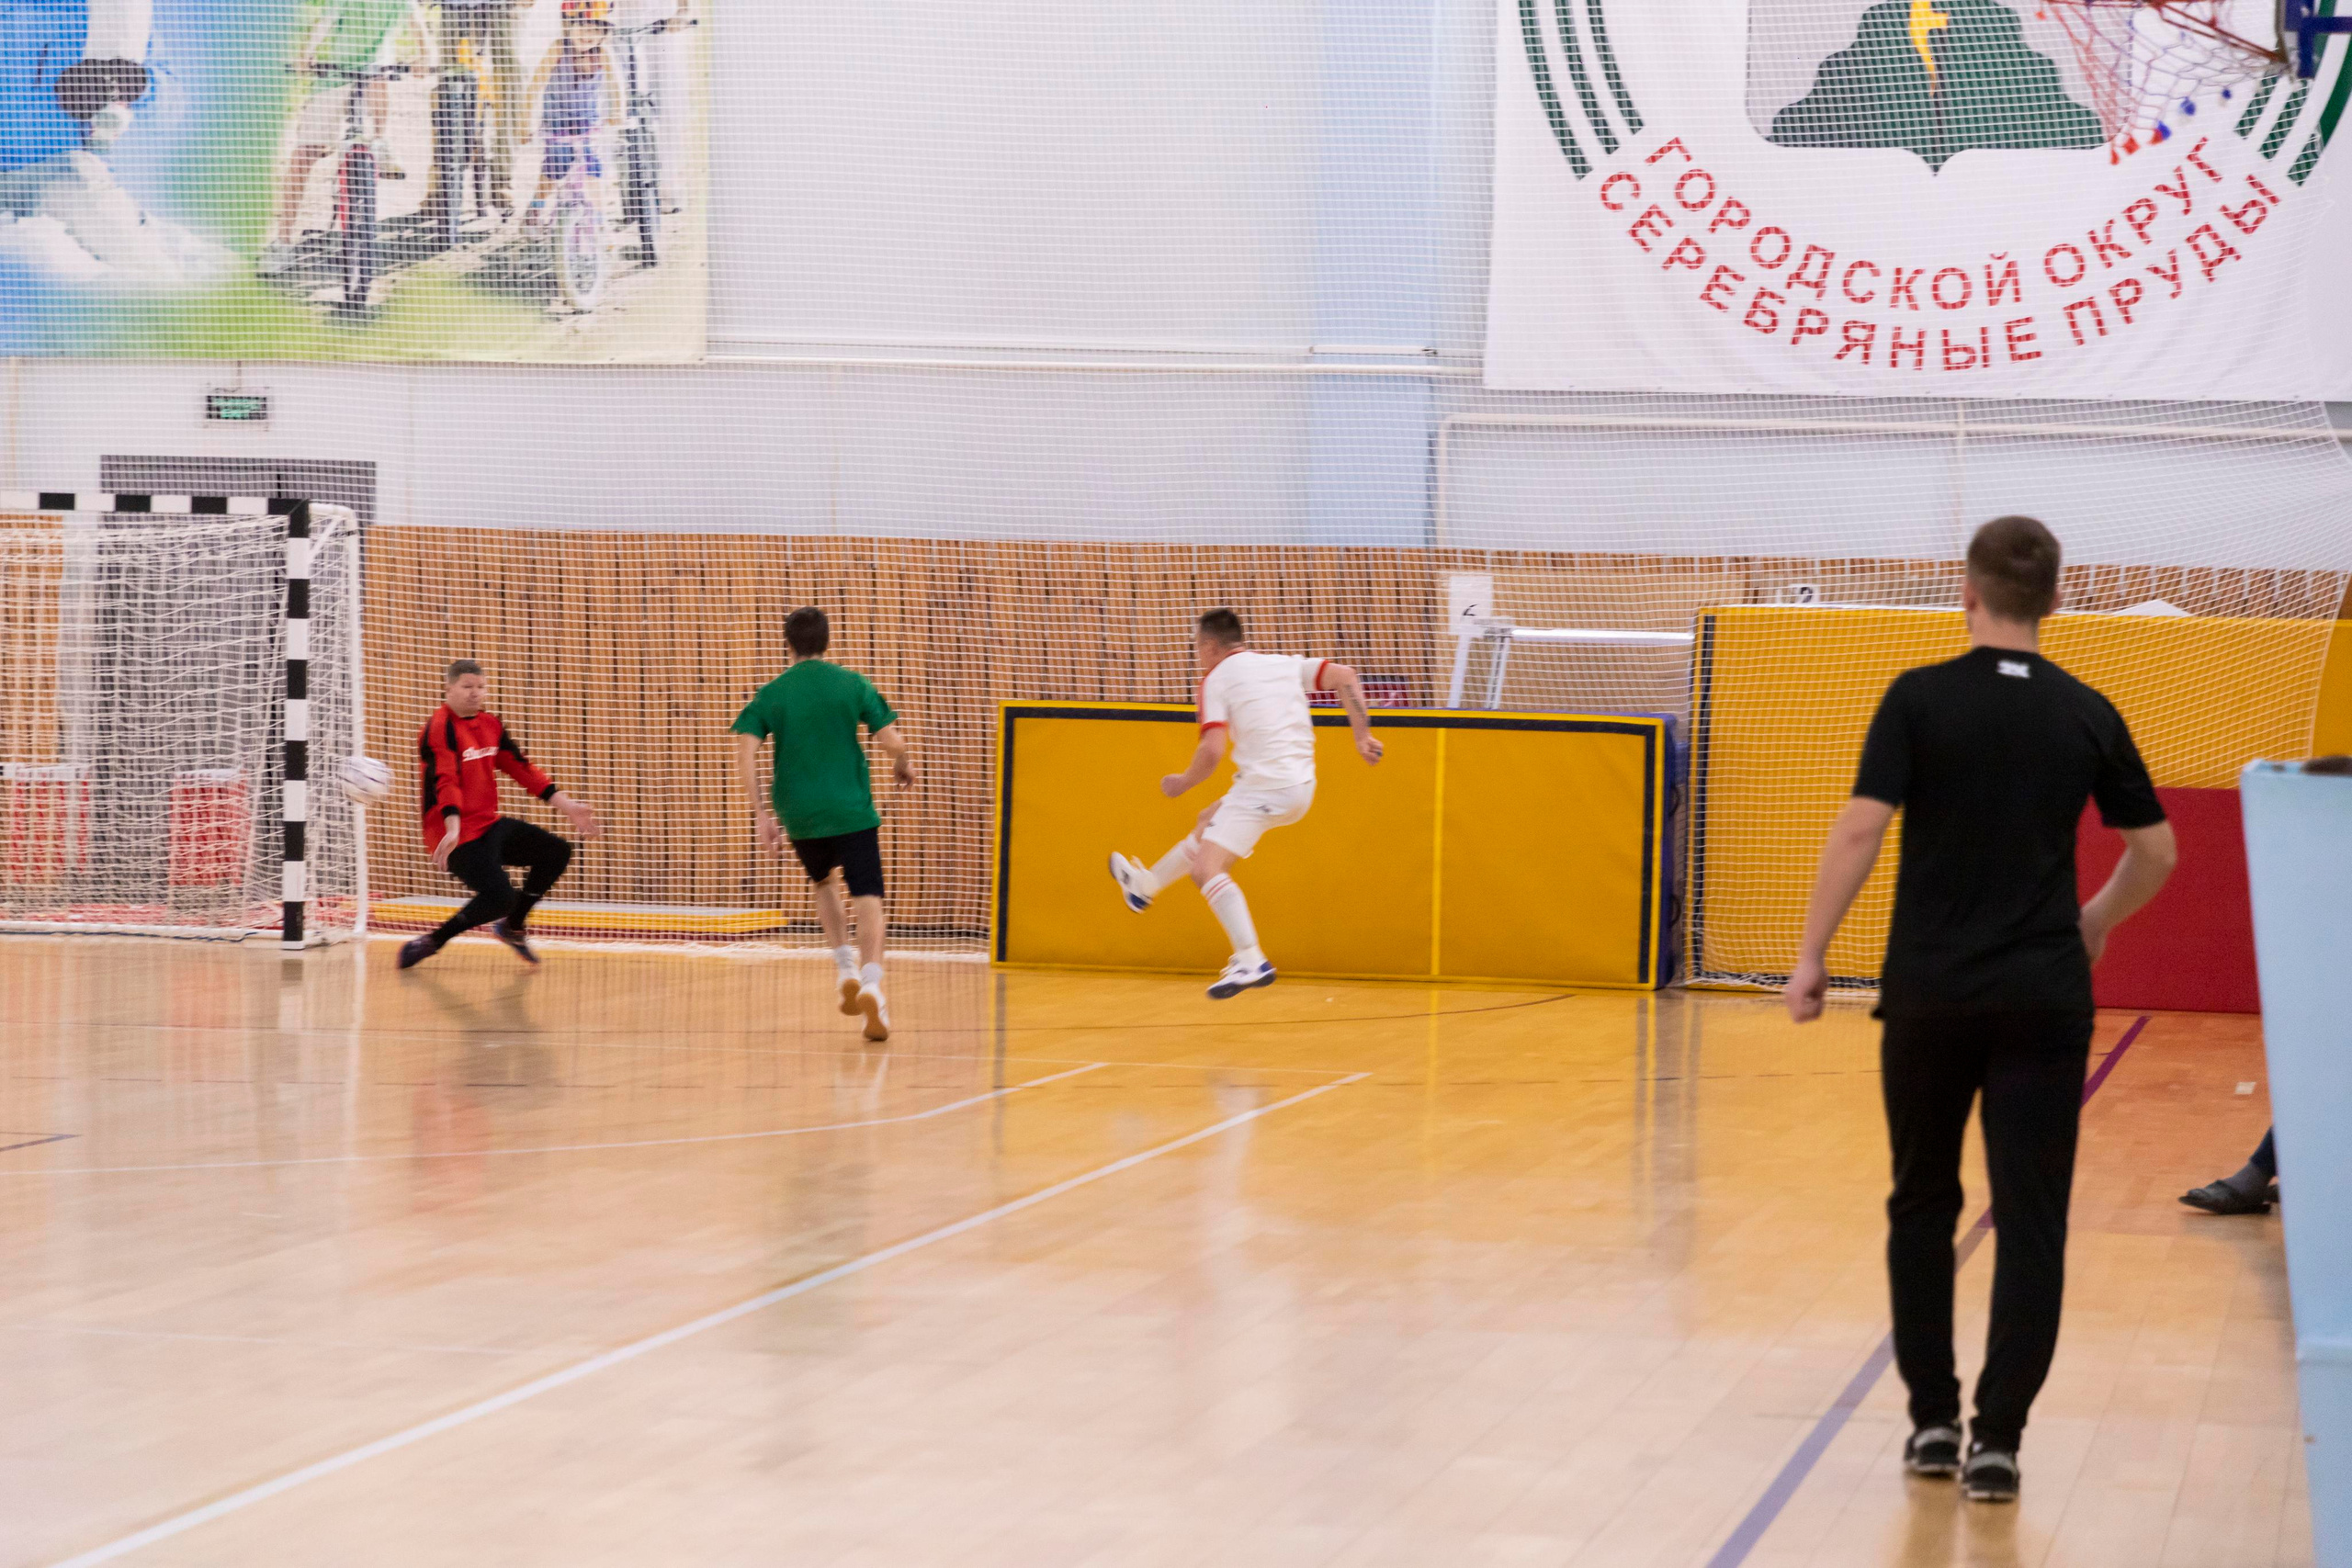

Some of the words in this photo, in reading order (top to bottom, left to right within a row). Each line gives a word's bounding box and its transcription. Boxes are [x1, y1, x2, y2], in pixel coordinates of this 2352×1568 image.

[1600, 171, 2042, 371] СЕРЕБРЯНЫЕ
[2063, 175, 2281, 346] ПРУДЫ
[1645, 136, 2022, 310] ГОРОДСКОЙ
[2044, 137, 2223, 288] ОКРУГ
